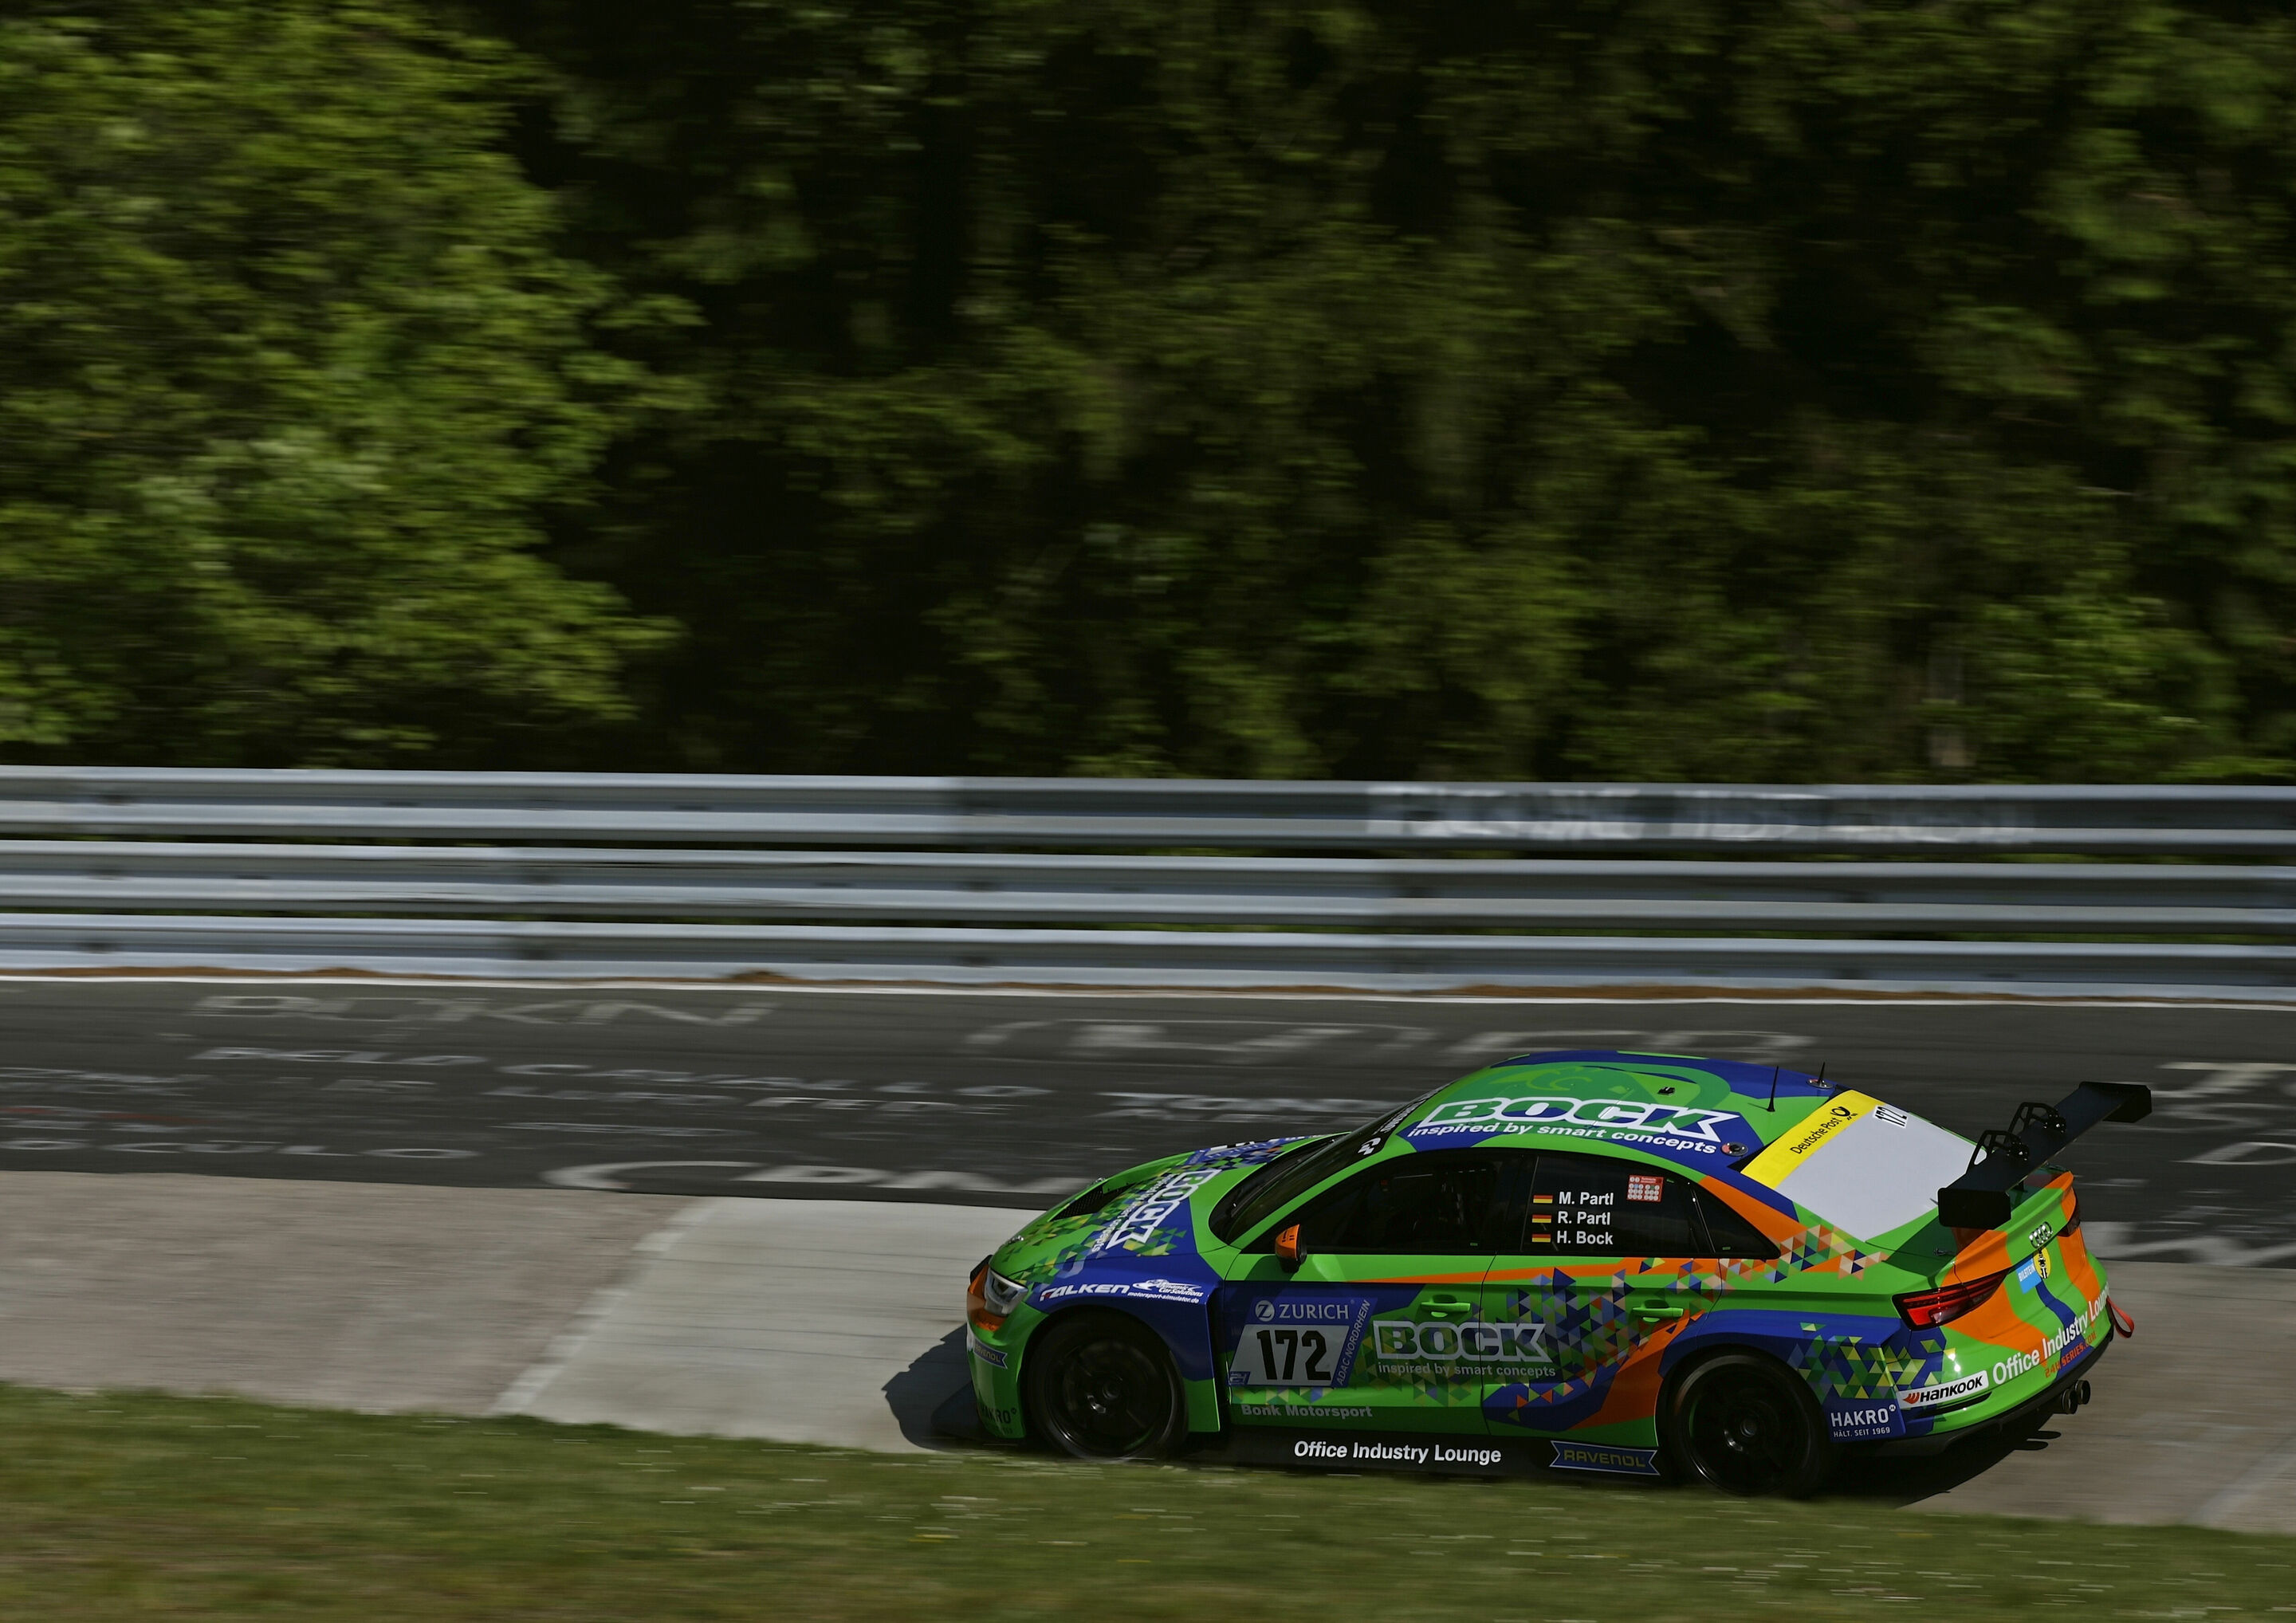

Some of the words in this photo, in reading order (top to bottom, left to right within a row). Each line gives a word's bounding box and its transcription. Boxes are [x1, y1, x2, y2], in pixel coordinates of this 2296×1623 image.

[1416, 1096, 1740, 1142] BOCK
[1875, 1106, 1907, 1126] 172
[1407, 1120, 1504, 1138] inspired
[1503, 1122, 1533, 1136] by
[1537, 1124, 1605, 1138] smart
[1611, 1130, 1717, 1155] concepts
[1790, 1127, 1828, 1154] Deutsche
[1820, 1117, 1843, 1130] Post
[1559, 1191, 1575, 1204] M.
[1580, 1192, 1614, 1205] Partl
[1105, 1169, 1222, 1250] BOCK
[1558, 1211, 1572, 1224] R.
[1577, 1211, 1610, 1225] Partl
[1557, 1230, 1571, 1244] H.
[1576, 1230, 1614, 1245] Bock
[1040, 1283, 1130, 1302] FALKEN
[1127, 1291, 1200, 1304] motorsport-simulator.de
[1279, 1303, 1350, 1320] ZURICH
[1335, 1358, 1350, 1385] ADAC
[1345, 1299, 1371, 1358] NORDRHEIN
[1373, 1320, 1553, 1363] BOCK
[1993, 1349, 2040, 1385] Office
[2042, 1311, 2089, 1360] Industry
[1256, 1330, 1331, 1381] 172
[1378, 1362, 1431, 1377] inspired
[1434, 1362, 1450, 1377] by
[1454, 1364, 1492, 1377] smart
[1495, 1365, 1556, 1378] concepts
[1241, 1404, 1281, 1417] Bonk
[1285, 1405, 1373, 1420] Motorsport
[1830, 1408, 1889, 1427] HAKRO
[1855, 1428, 1869, 1436] SEIT
[1873, 1426, 1890, 1436] 1969
[1294, 1440, 1347, 1459] Office
[1352, 1442, 1429, 1464] Industry
[1434, 1445, 1502, 1466] Lounge
[1563, 1449, 1646, 1468] RAVENOL
